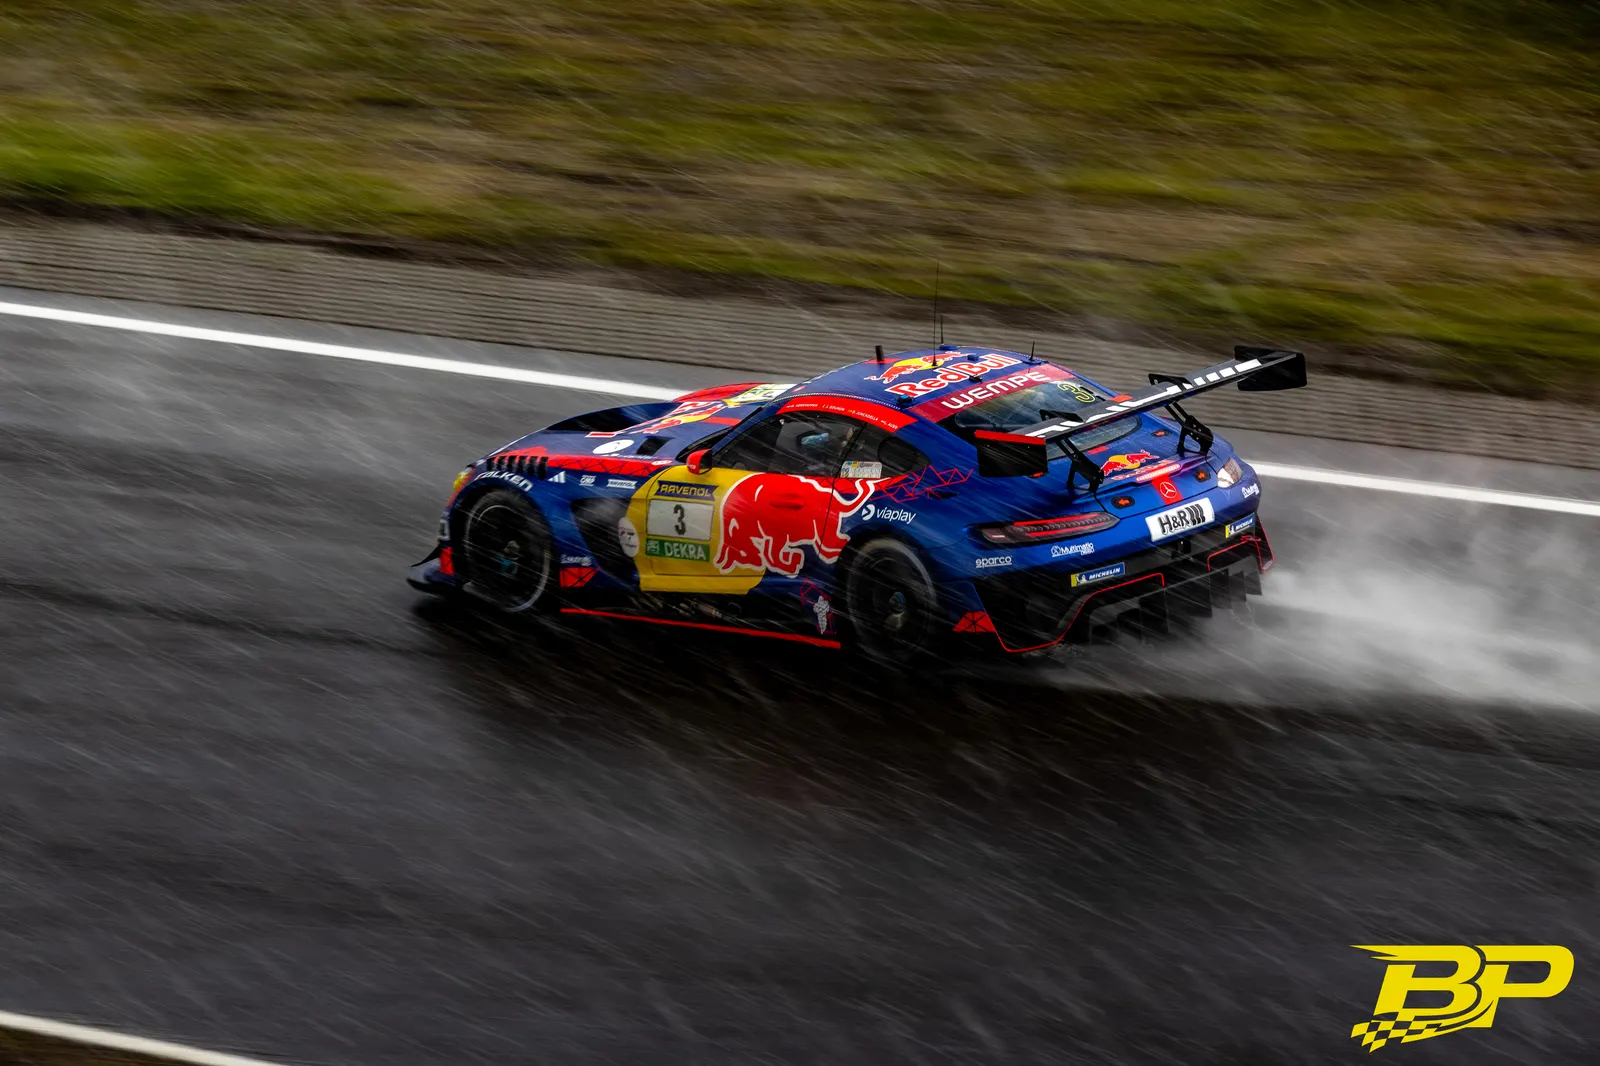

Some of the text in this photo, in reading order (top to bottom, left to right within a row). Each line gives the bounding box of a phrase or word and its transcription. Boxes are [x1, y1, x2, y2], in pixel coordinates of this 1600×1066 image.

[885, 353, 1023, 397] Red Bull
[942, 371, 1051, 409] WEMPE
[1057, 381, 1096, 403] 3
[473, 470, 534, 492] FALKEN
[660, 484, 712, 497] RAVENOL
[673, 504, 686, 535] 3
[877, 507, 916, 525] viaplay
[1158, 510, 1190, 535] H&R
[664, 542, 706, 561] DEKRA
[1088, 567, 1121, 581] MICHELIN
